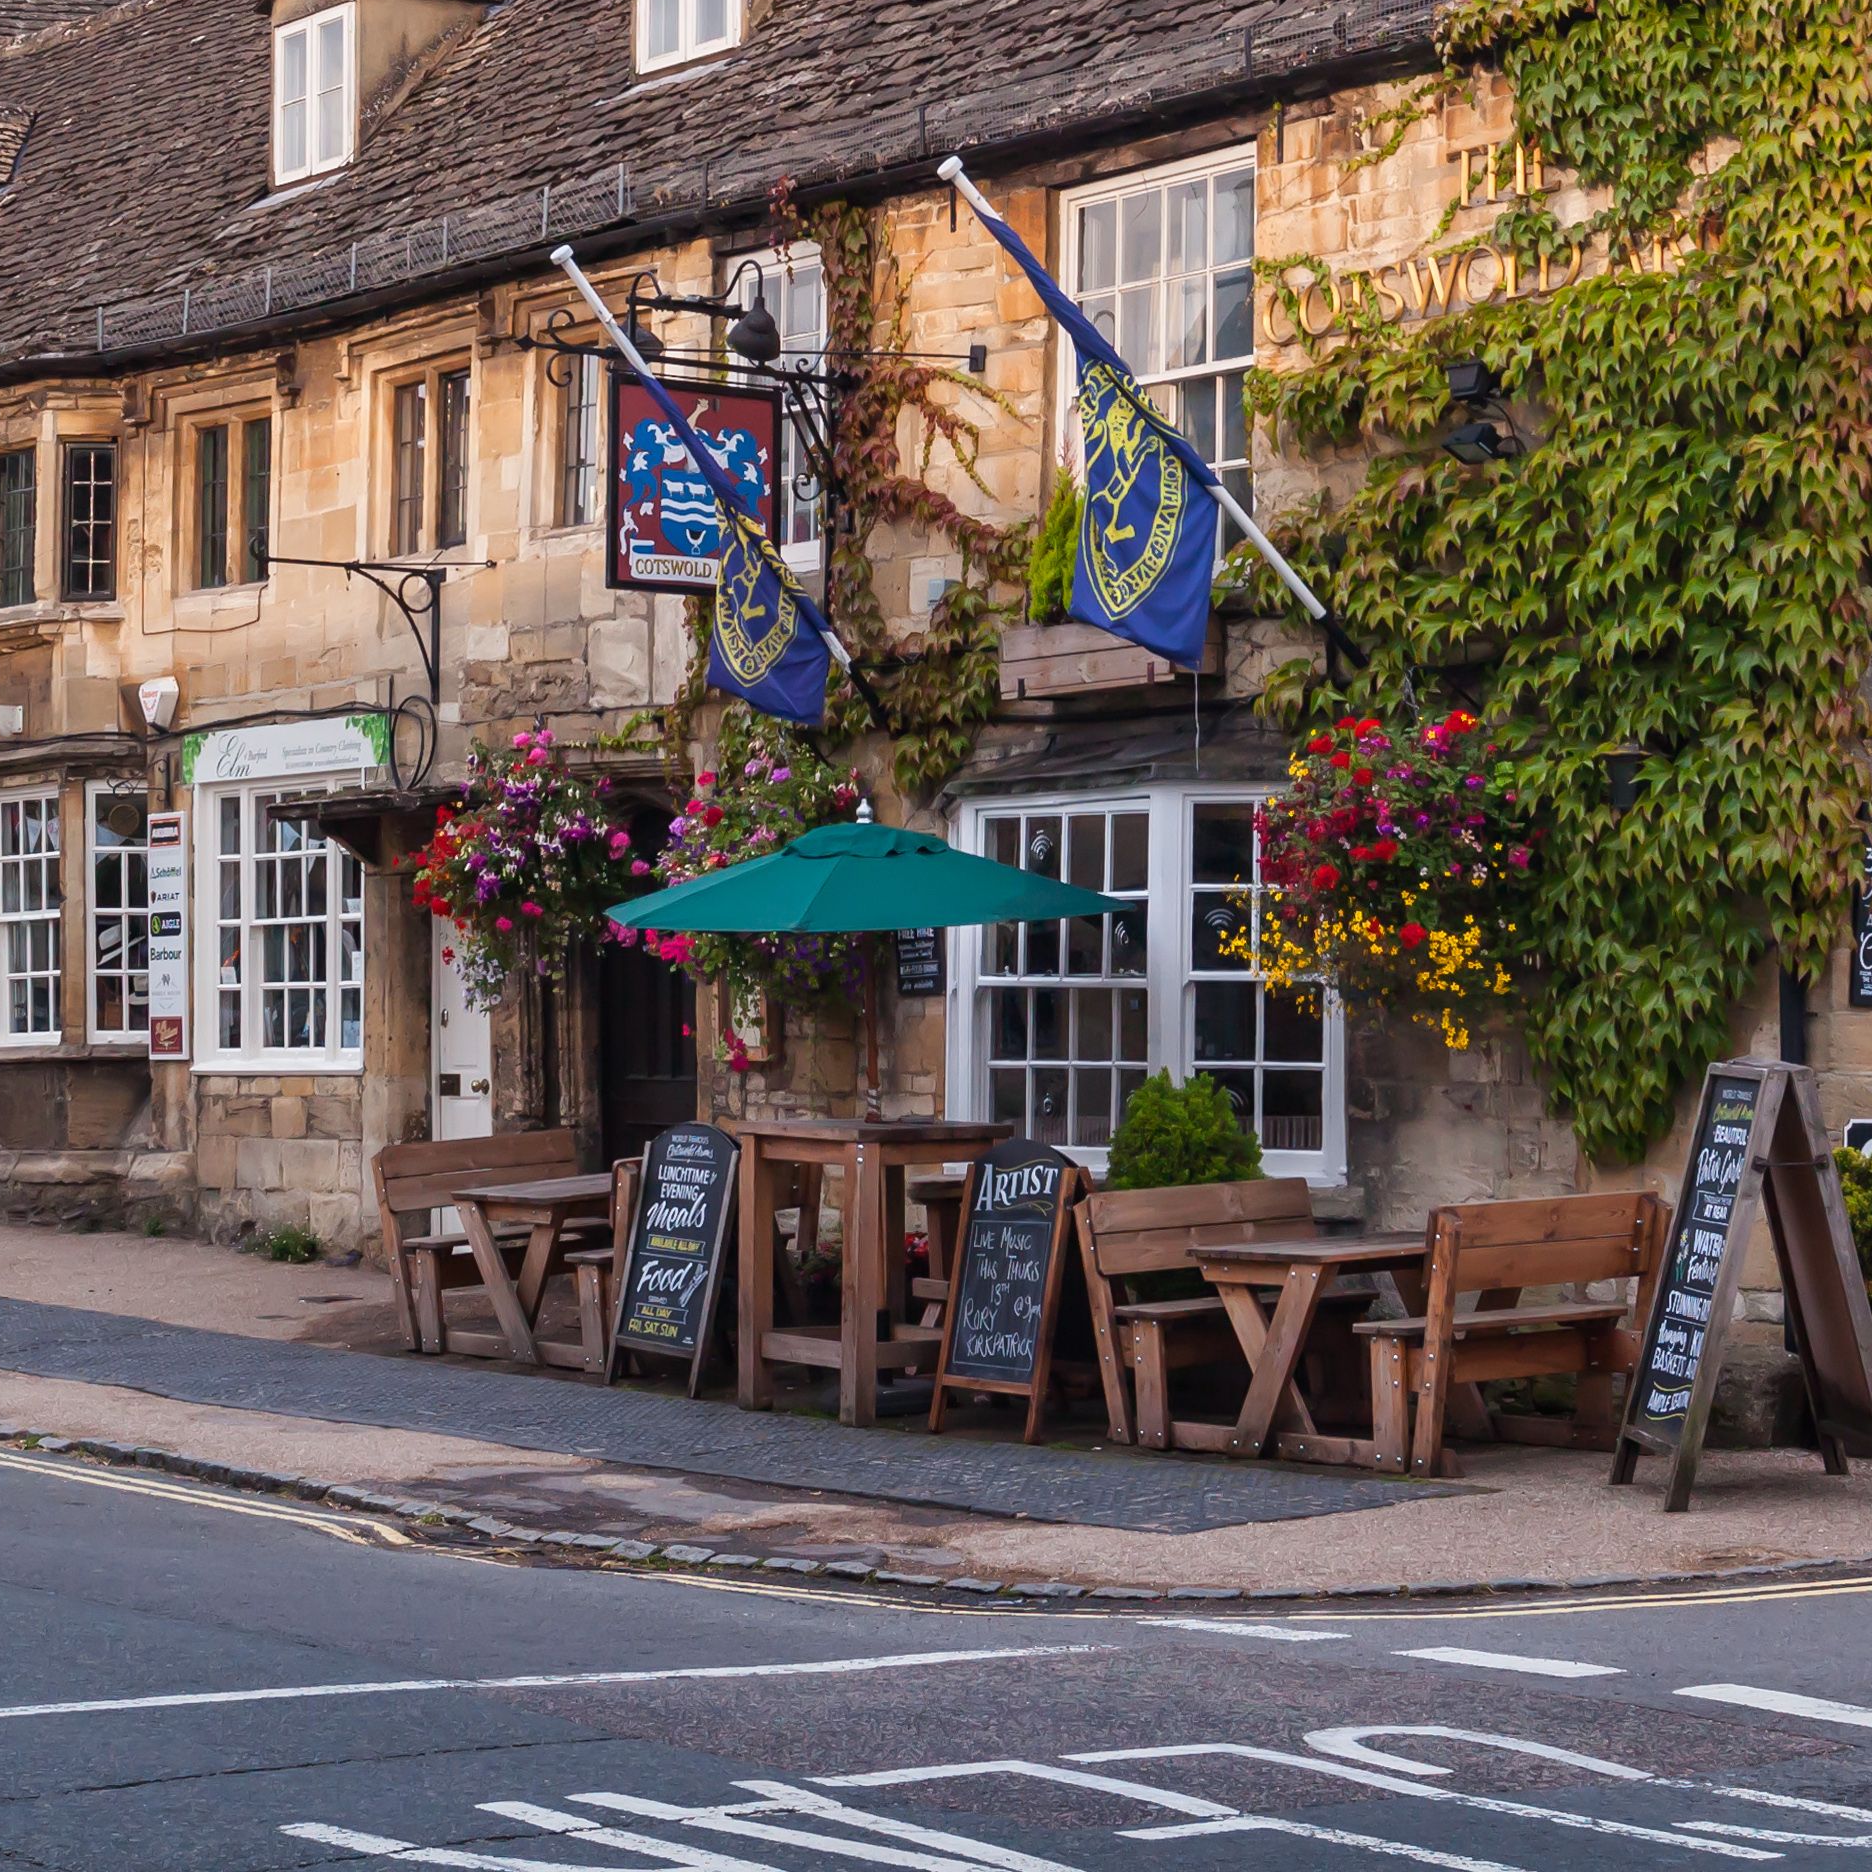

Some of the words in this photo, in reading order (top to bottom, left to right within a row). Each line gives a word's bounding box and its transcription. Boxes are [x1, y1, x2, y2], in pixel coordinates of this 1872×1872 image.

[635, 557, 713, 578] COTSWOLD
[216, 733, 252, 778] Elm
[156, 892, 180, 902] ARIAT
[161, 917, 181, 930] AIGLE
[150, 945, 182, 962] Barbour
[658, 1164, 710, 1185] LUNCHTIME
[660, 1182, 700, 1201] EVENING
[974, 1162, 1059, 1212] ARTIST
[973, 1225, 995, 1250] LIVE
[636, 1260, 693, 1293] Food
[976, 1253, 998, 1280] THIS
[640, 1305, 655, 1316] ALL
[655, 1308, 673, 1319] DAY
[963, 1297, 999, 1332] RORY
[659, 1323, 679, 1338] SUN
[966, 1331, 1033, 1362] KIRKPATRICK
[1651, 1346, 1687, 1378] BASKETS
